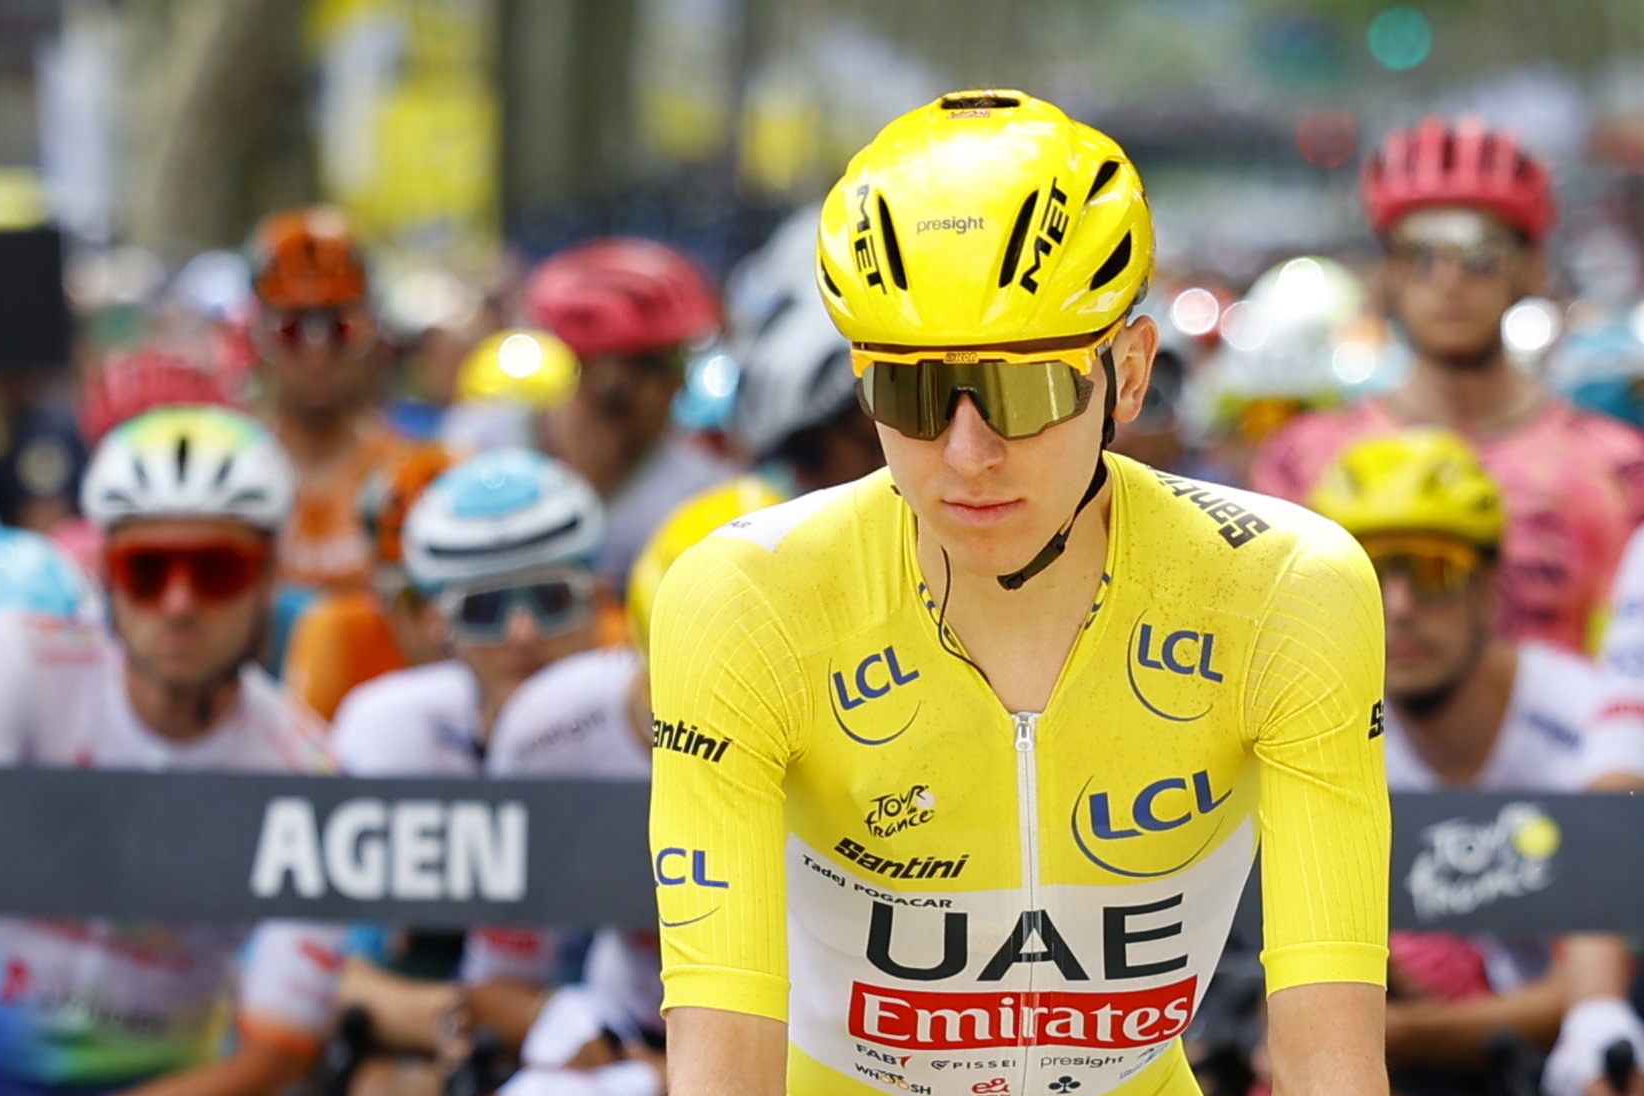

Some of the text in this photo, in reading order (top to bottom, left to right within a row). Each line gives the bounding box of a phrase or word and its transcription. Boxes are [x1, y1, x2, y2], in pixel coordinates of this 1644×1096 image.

[854, 184, 888, 295] MET
[916, 216, 985, 235] presight
[1018, 176, 1070, 295] MET
[832, 645, 921, 712] LCL
[1136, 624, 1225, 683] LCL
[1088, 769, 1234, 840] LCL
[250, 796, 529, 902] AGEN
[654, 846, 730, 889] CL
[833, 837, 970, 879] Santini
[803, 854, 953, 909] Tadej POGACAR
[865, 892, 1189, 981] UAE
[861, 992, 1190, 1044] Emirates
[952, 1059, 1016, 1069] PISSEI
[1041, 1056, 1125, 1069] presight
